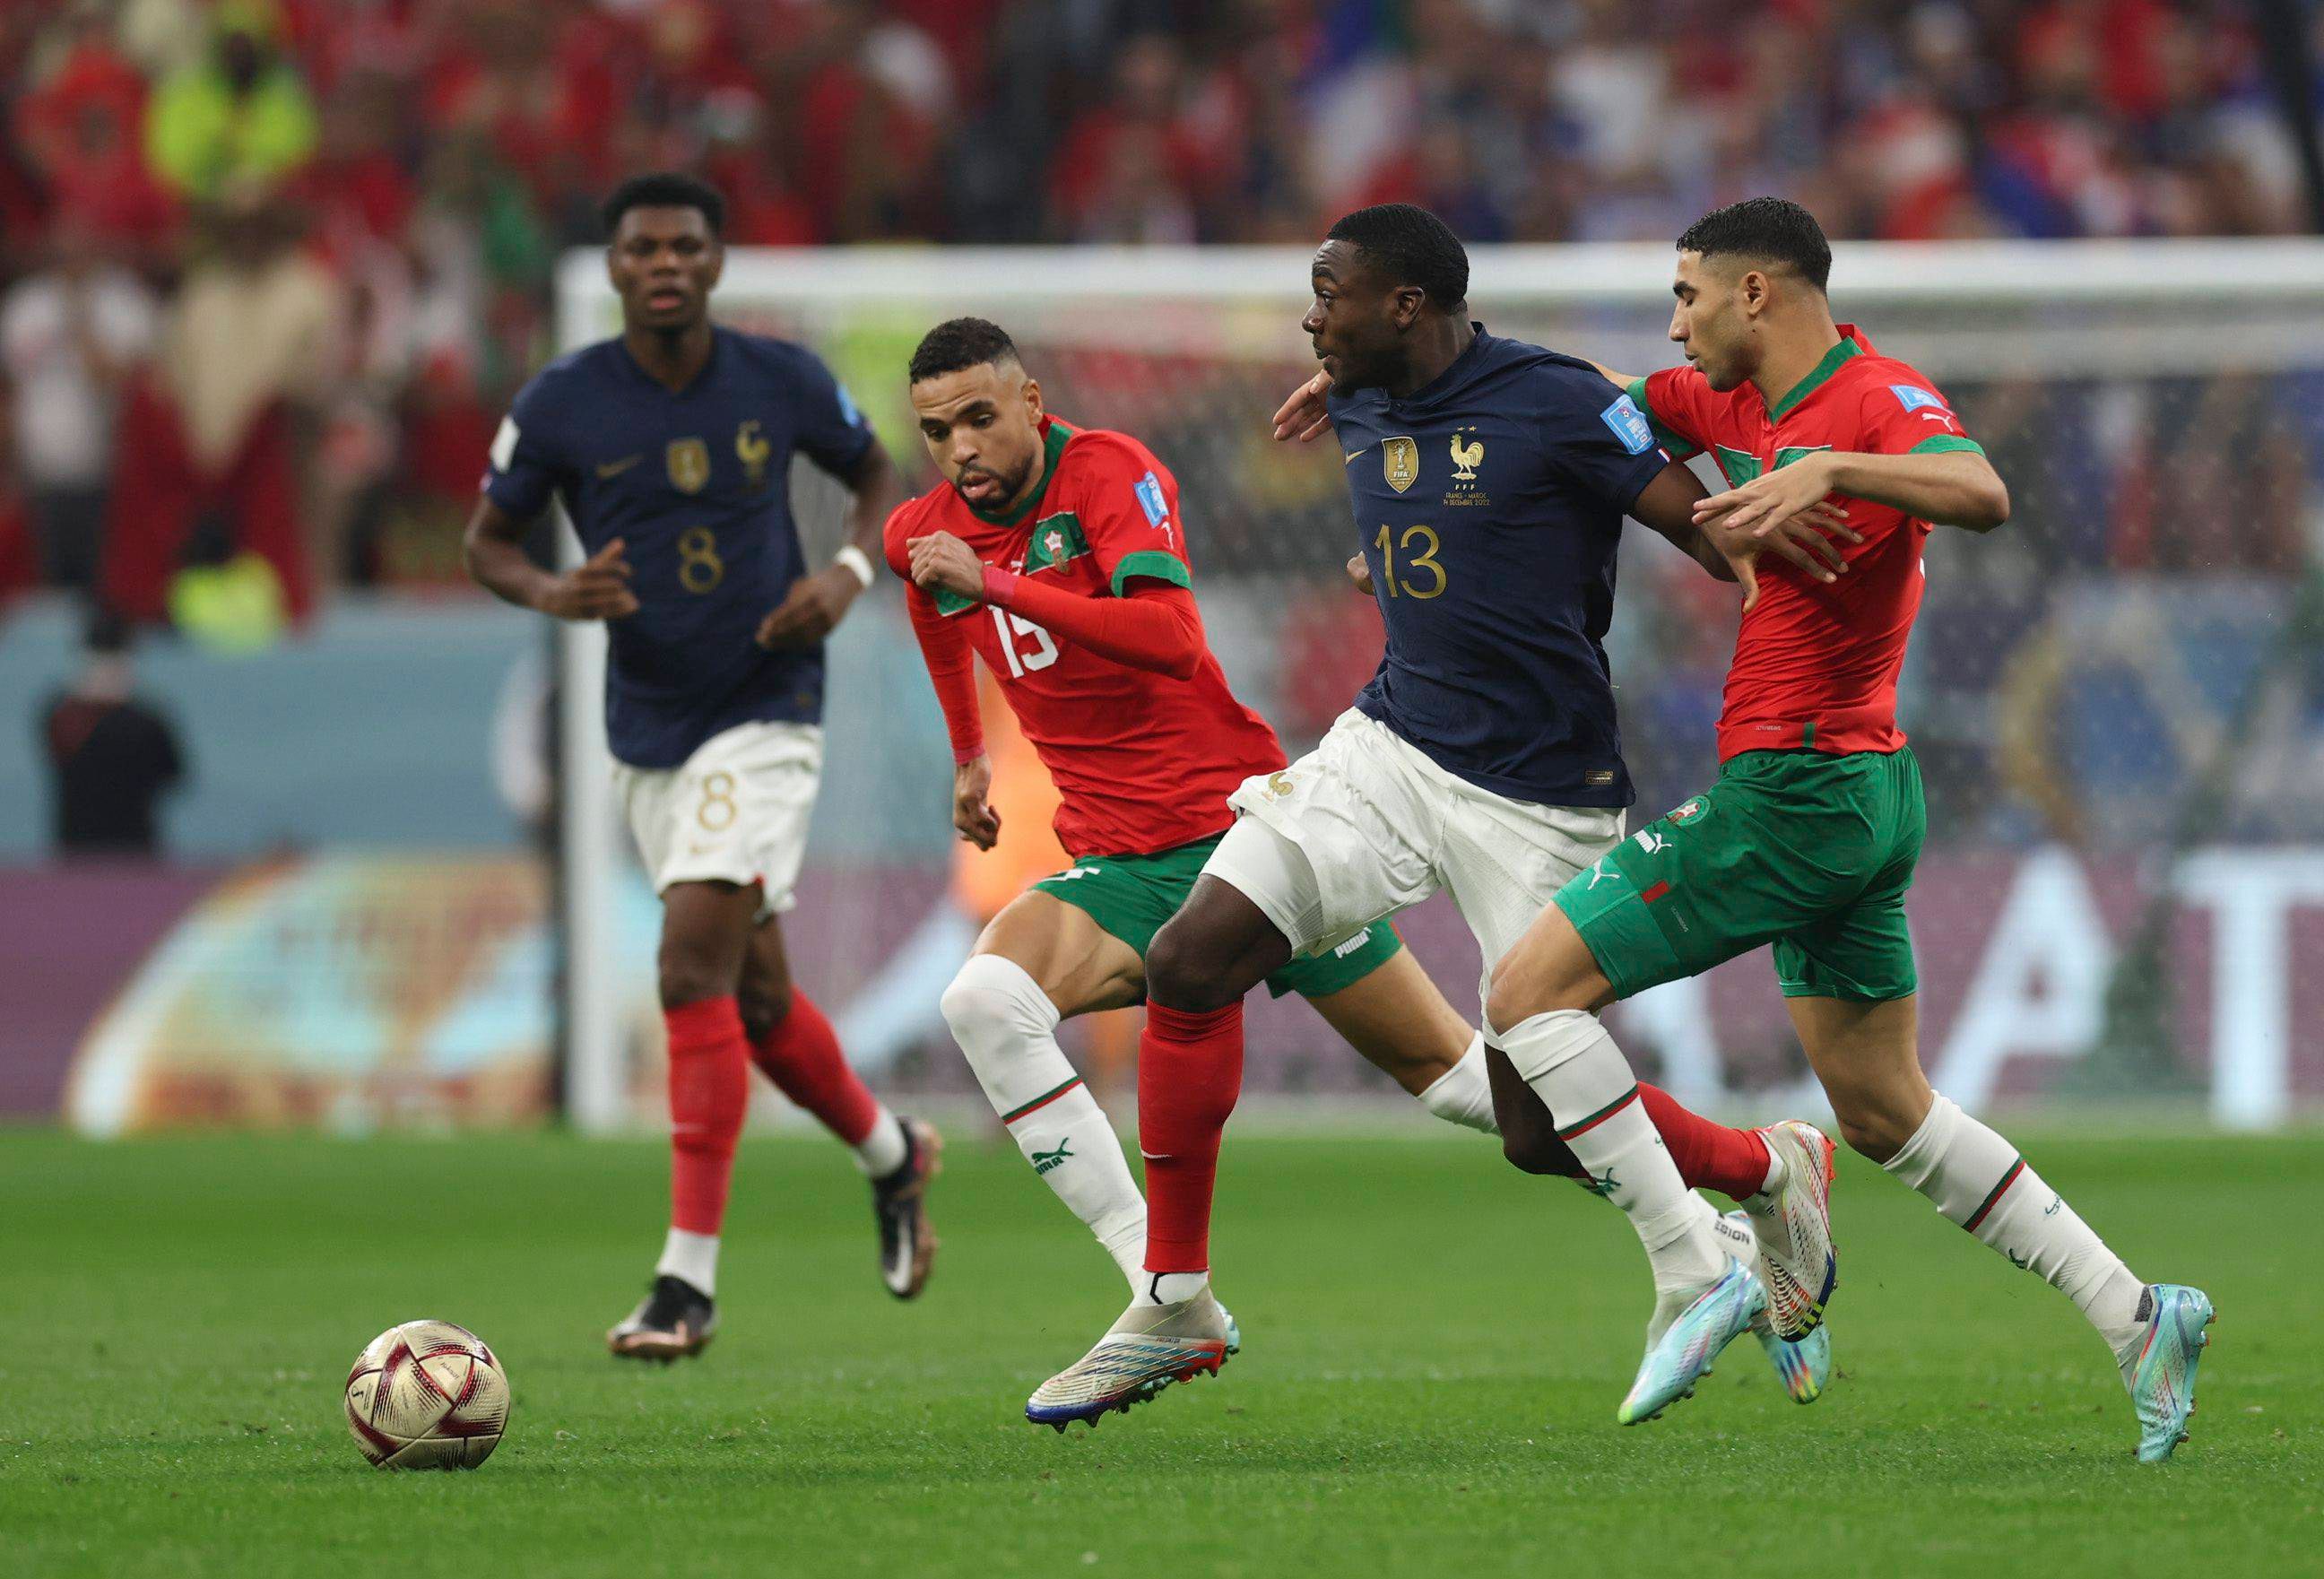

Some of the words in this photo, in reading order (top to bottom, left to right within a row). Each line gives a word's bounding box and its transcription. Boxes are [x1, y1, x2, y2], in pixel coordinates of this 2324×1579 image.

[677, 525, 724, 594] 8
[1374, 524, 1447, 599] 13
[987, 603, 1059, 679] 15
[697, 769, 737, 831] 8
[1334, 930, 1370, 959] PUMA
